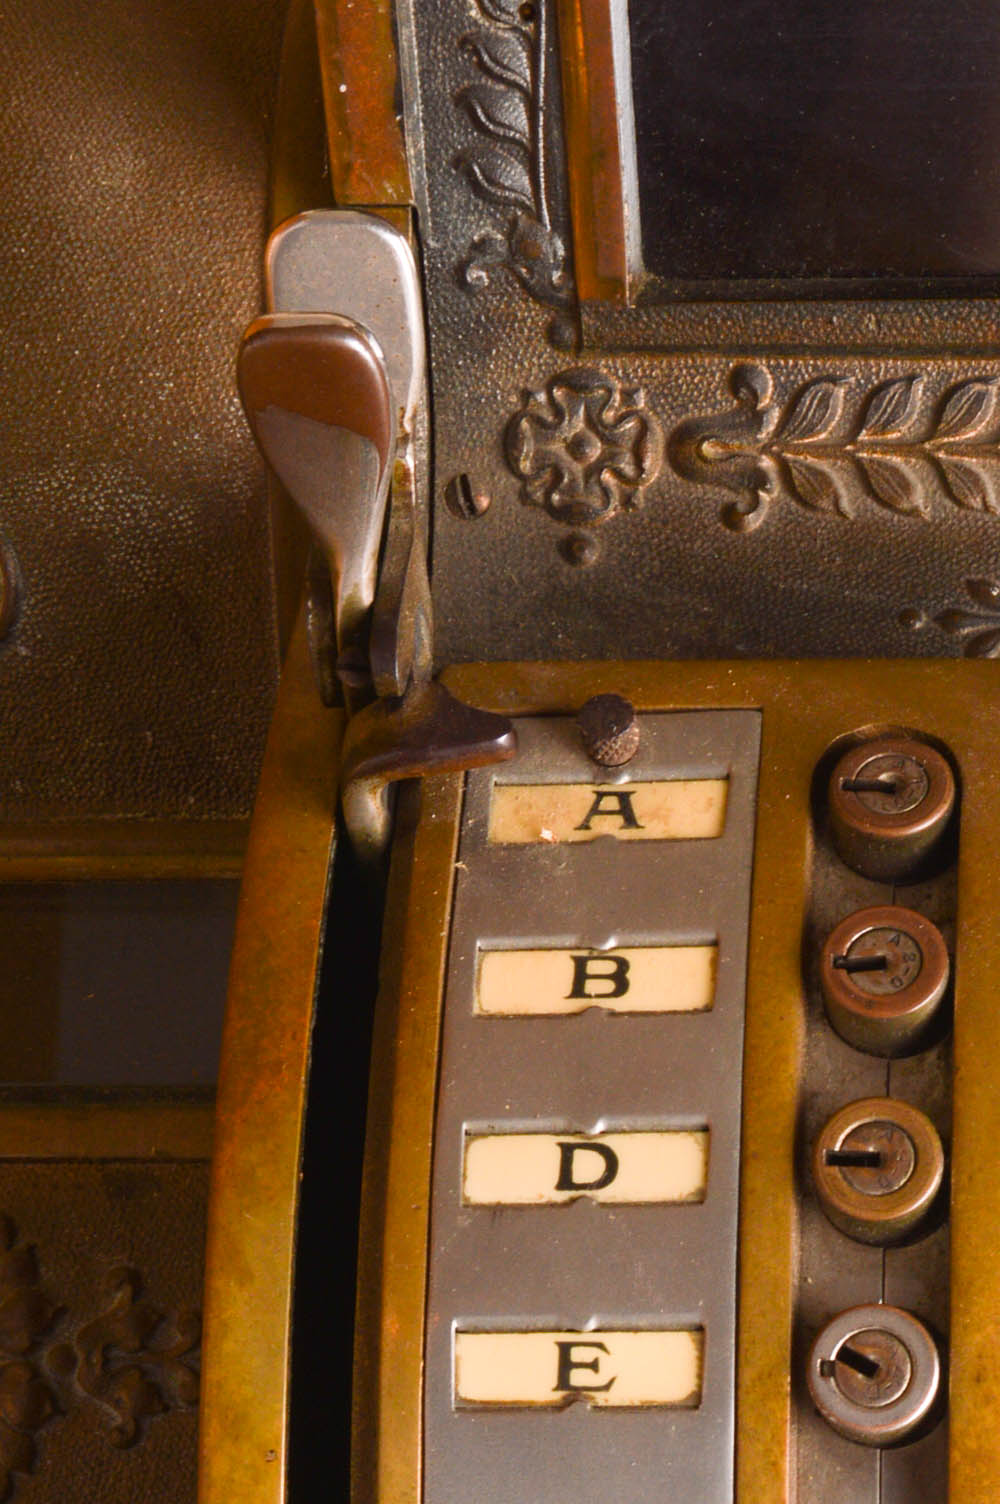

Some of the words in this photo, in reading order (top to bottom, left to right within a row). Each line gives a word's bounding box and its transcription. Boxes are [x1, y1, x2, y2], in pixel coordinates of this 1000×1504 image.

[574, 790, 644, 831] A
[569, 955, 631, 999] B
[555, 1142, 619, 1191] D
[552, 1341, 618, 1392] E
